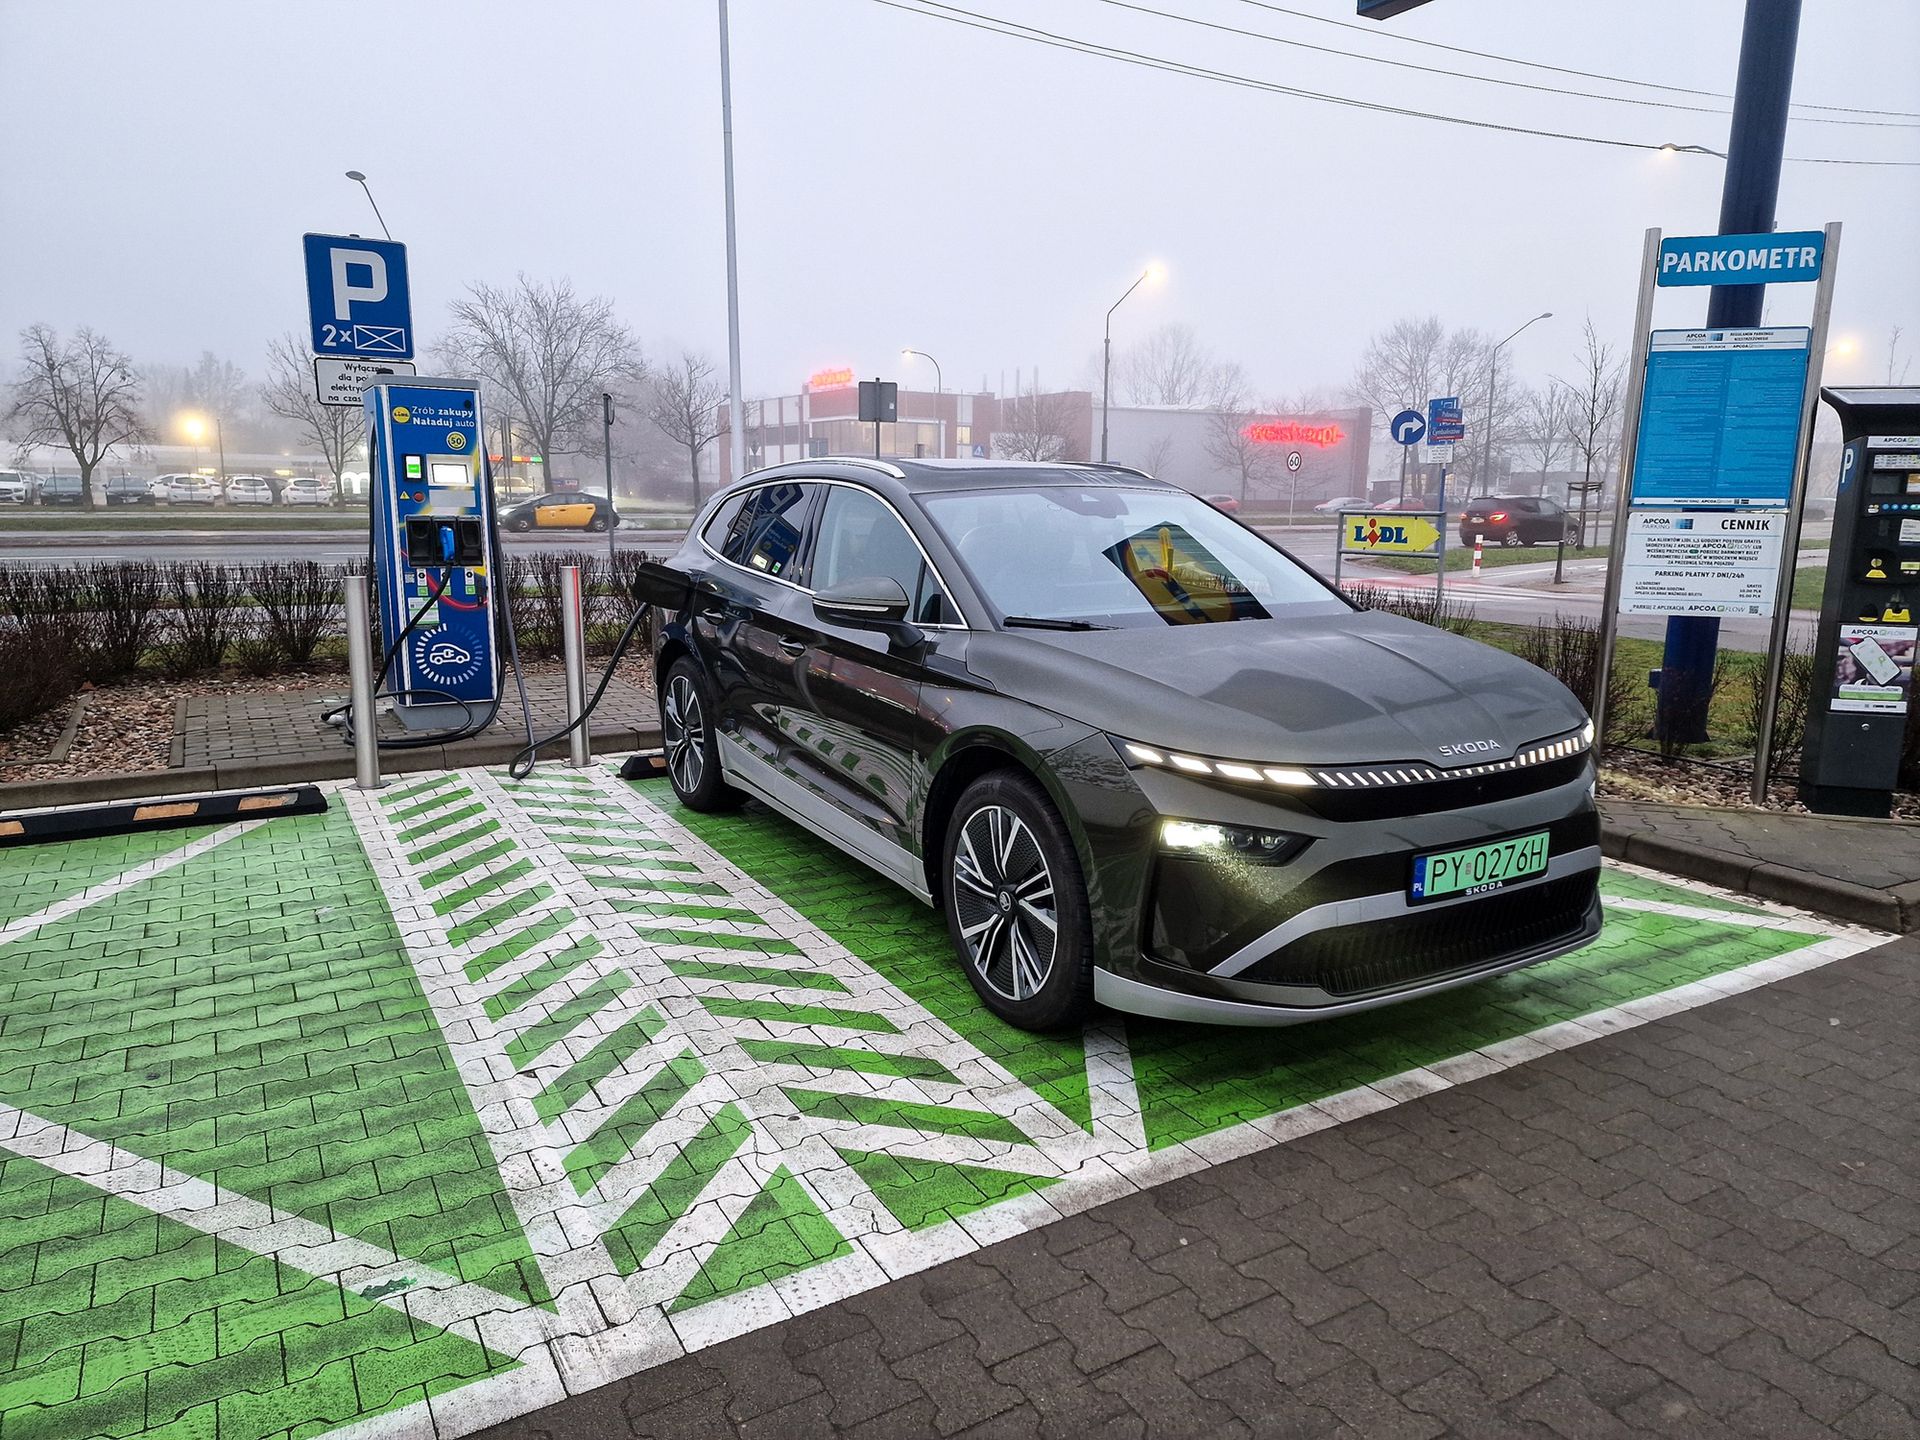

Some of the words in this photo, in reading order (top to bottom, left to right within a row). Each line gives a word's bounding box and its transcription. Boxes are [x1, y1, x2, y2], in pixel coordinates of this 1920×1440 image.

[1662, 246, 1817, 273] PARKOMETR
[330, 247, 388, 321] P
[411, 405, 435, 415] Zrób
[438, 407, 474, 418] zakupy
[412, 417, 453, 429] Naładuj
[455, 420, 475, 428] auto
[450, 436, 463, 446] 50
[1290, 455, 1300, 467] 60
[1841, 448, 1855, 484] P
[1721, 519, 1770, 531] CENNIK
[1654, 570, 1684, 578] PARKING
[1716, 571, 1745, 579] DNI/24h
[1430, 855, 1465, 892] PY
[1473, 837, 1545, 882] 0276H
[1412, 882, 1424, 892] PL
[1465, 881, 1504, 896] SKODA
